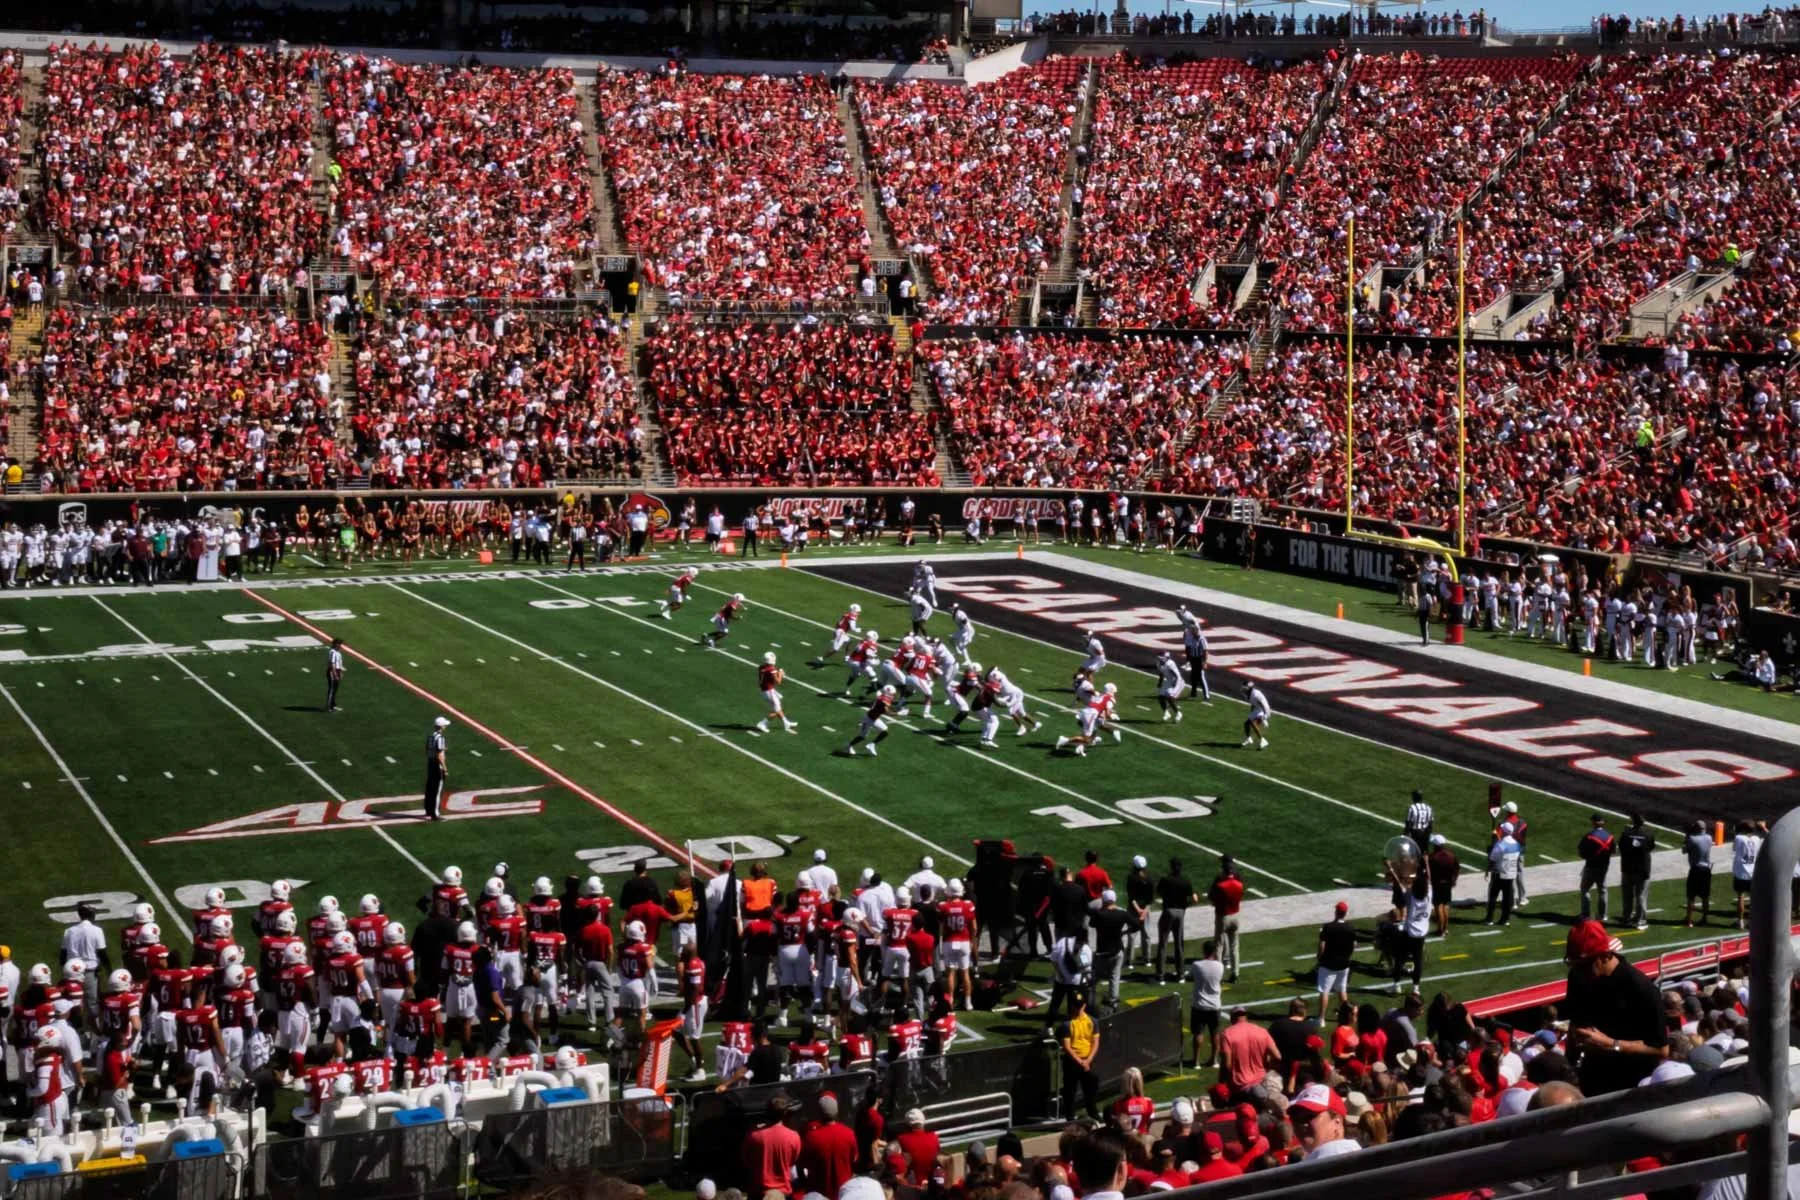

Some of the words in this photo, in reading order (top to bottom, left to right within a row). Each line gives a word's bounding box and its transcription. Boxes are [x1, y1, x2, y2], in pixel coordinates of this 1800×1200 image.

[771, 497, 867, 521] LOUSILE
[962, 496, 1063, 520] CARDIALS
[1289, 538, 1318, 569] FOR
[1321, 543, 1349, 575] THE
[934, 574, 1797, 790] CARDINALS
[141, 785, 545, 845] ACC
[1030, 796, 1212, 829] 10
[575, 835, 785, 874] 20
[43, 879, 277, 924] 30
[502, 931, 511, 947] 2
